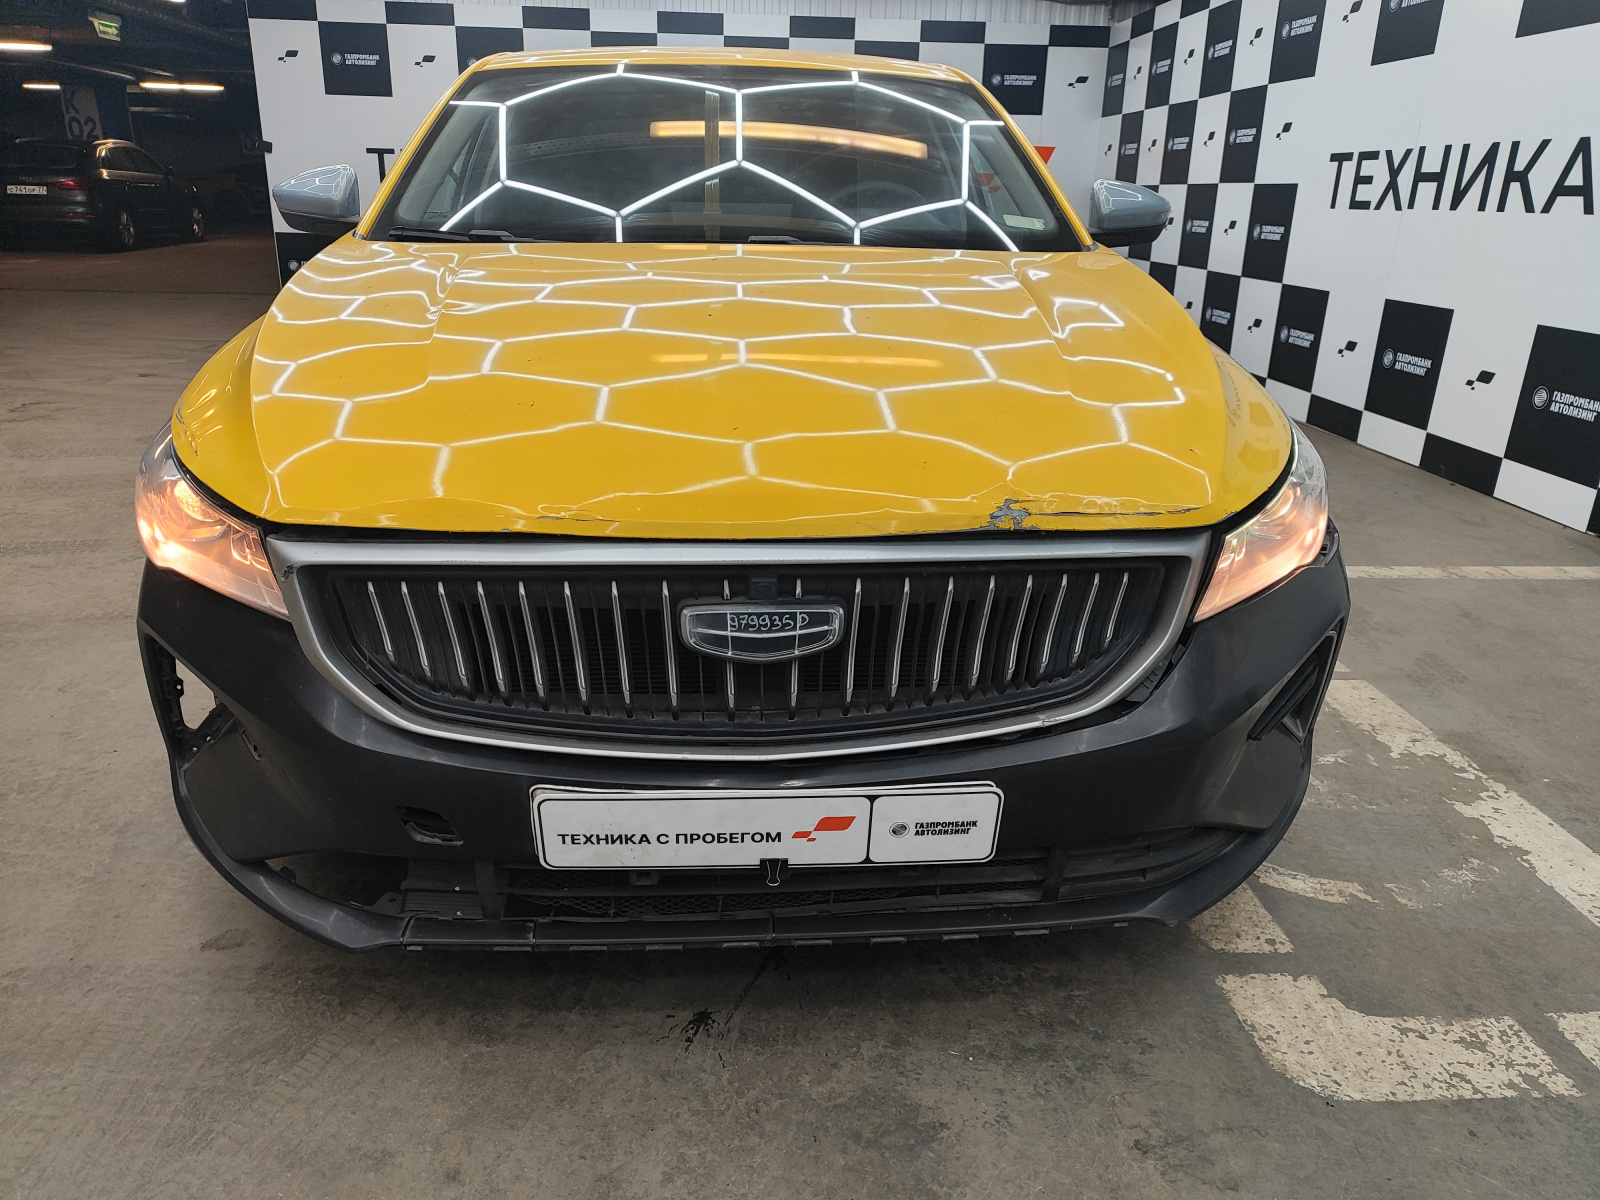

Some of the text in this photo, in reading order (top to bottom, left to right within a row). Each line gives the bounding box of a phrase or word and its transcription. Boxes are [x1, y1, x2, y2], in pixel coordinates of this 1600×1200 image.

[1329, 136, 1594, 215] ТЕХНИКА
[1396, 352, 1433, 369] ГАЗПРОМБАНК
[1394, 362, 1427, 377] АВТОЛИЗИНГ
[1549, 401, 1598, 422] АВТОЛИЗИНГ
[914, 820, 978, 829] ГАЗПРОМБАНК
[914, 827, 971, 836] АВТОЛИЗИНГ
[557, 831, 782, 845] ТЕХНИКА С ПРОБЕГОМ
